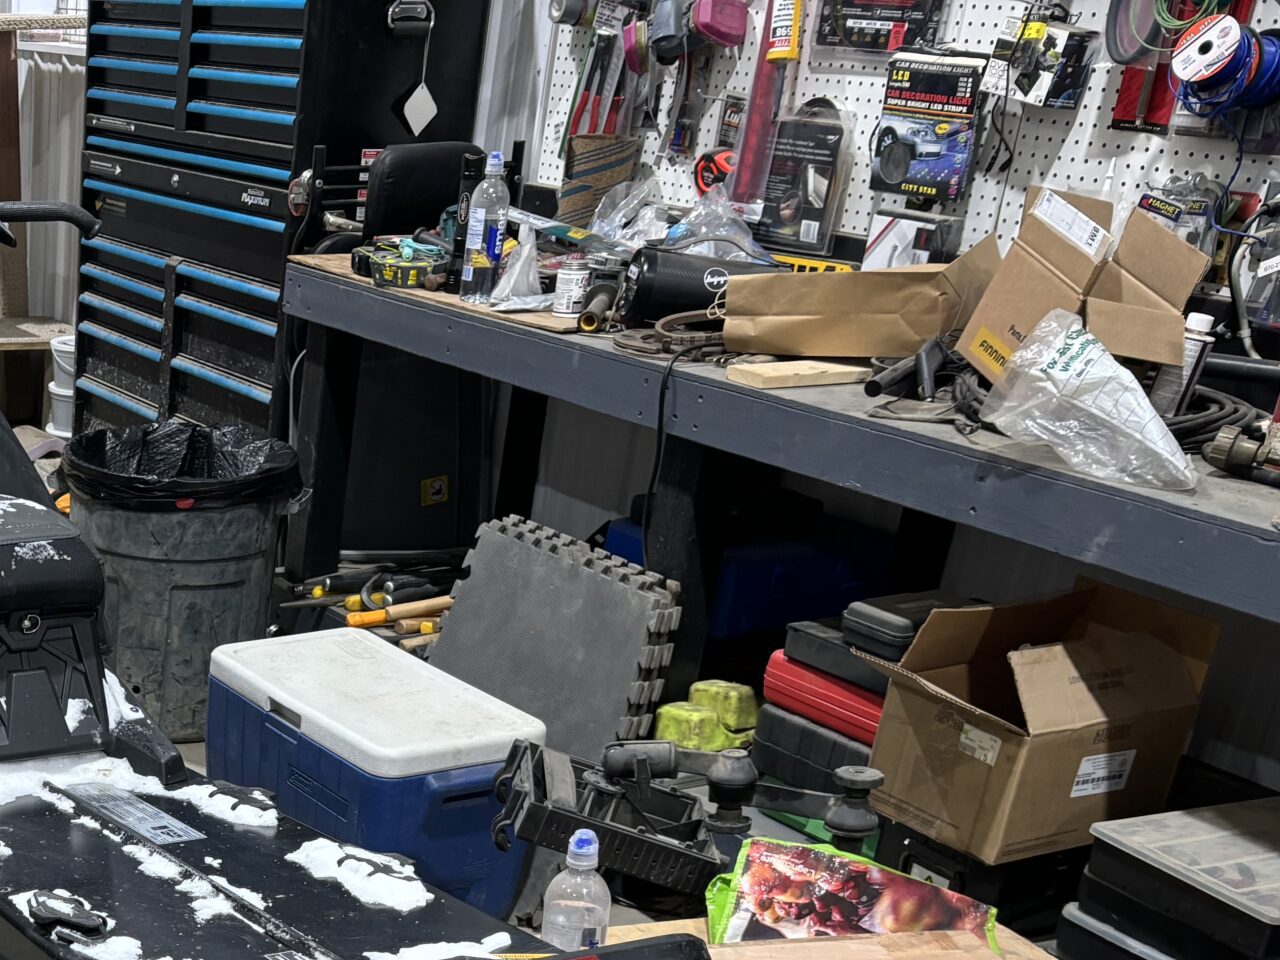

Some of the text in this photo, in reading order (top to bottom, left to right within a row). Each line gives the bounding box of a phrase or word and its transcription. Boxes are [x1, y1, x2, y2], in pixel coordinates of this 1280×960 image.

[892, 70, 910, 81] LED
[952, 66, 974, 74] LIGHT
[887, 89, 973, 106] CAR DECORATION LIGHT
[887, 98, 968, 113] SUPER BRIGHT LED STRIPE
[900, 182, 937, 195] CITY STAR
[1148, 197, 1180, 218] MAGNET
[495, 208, 507, 255] smart
